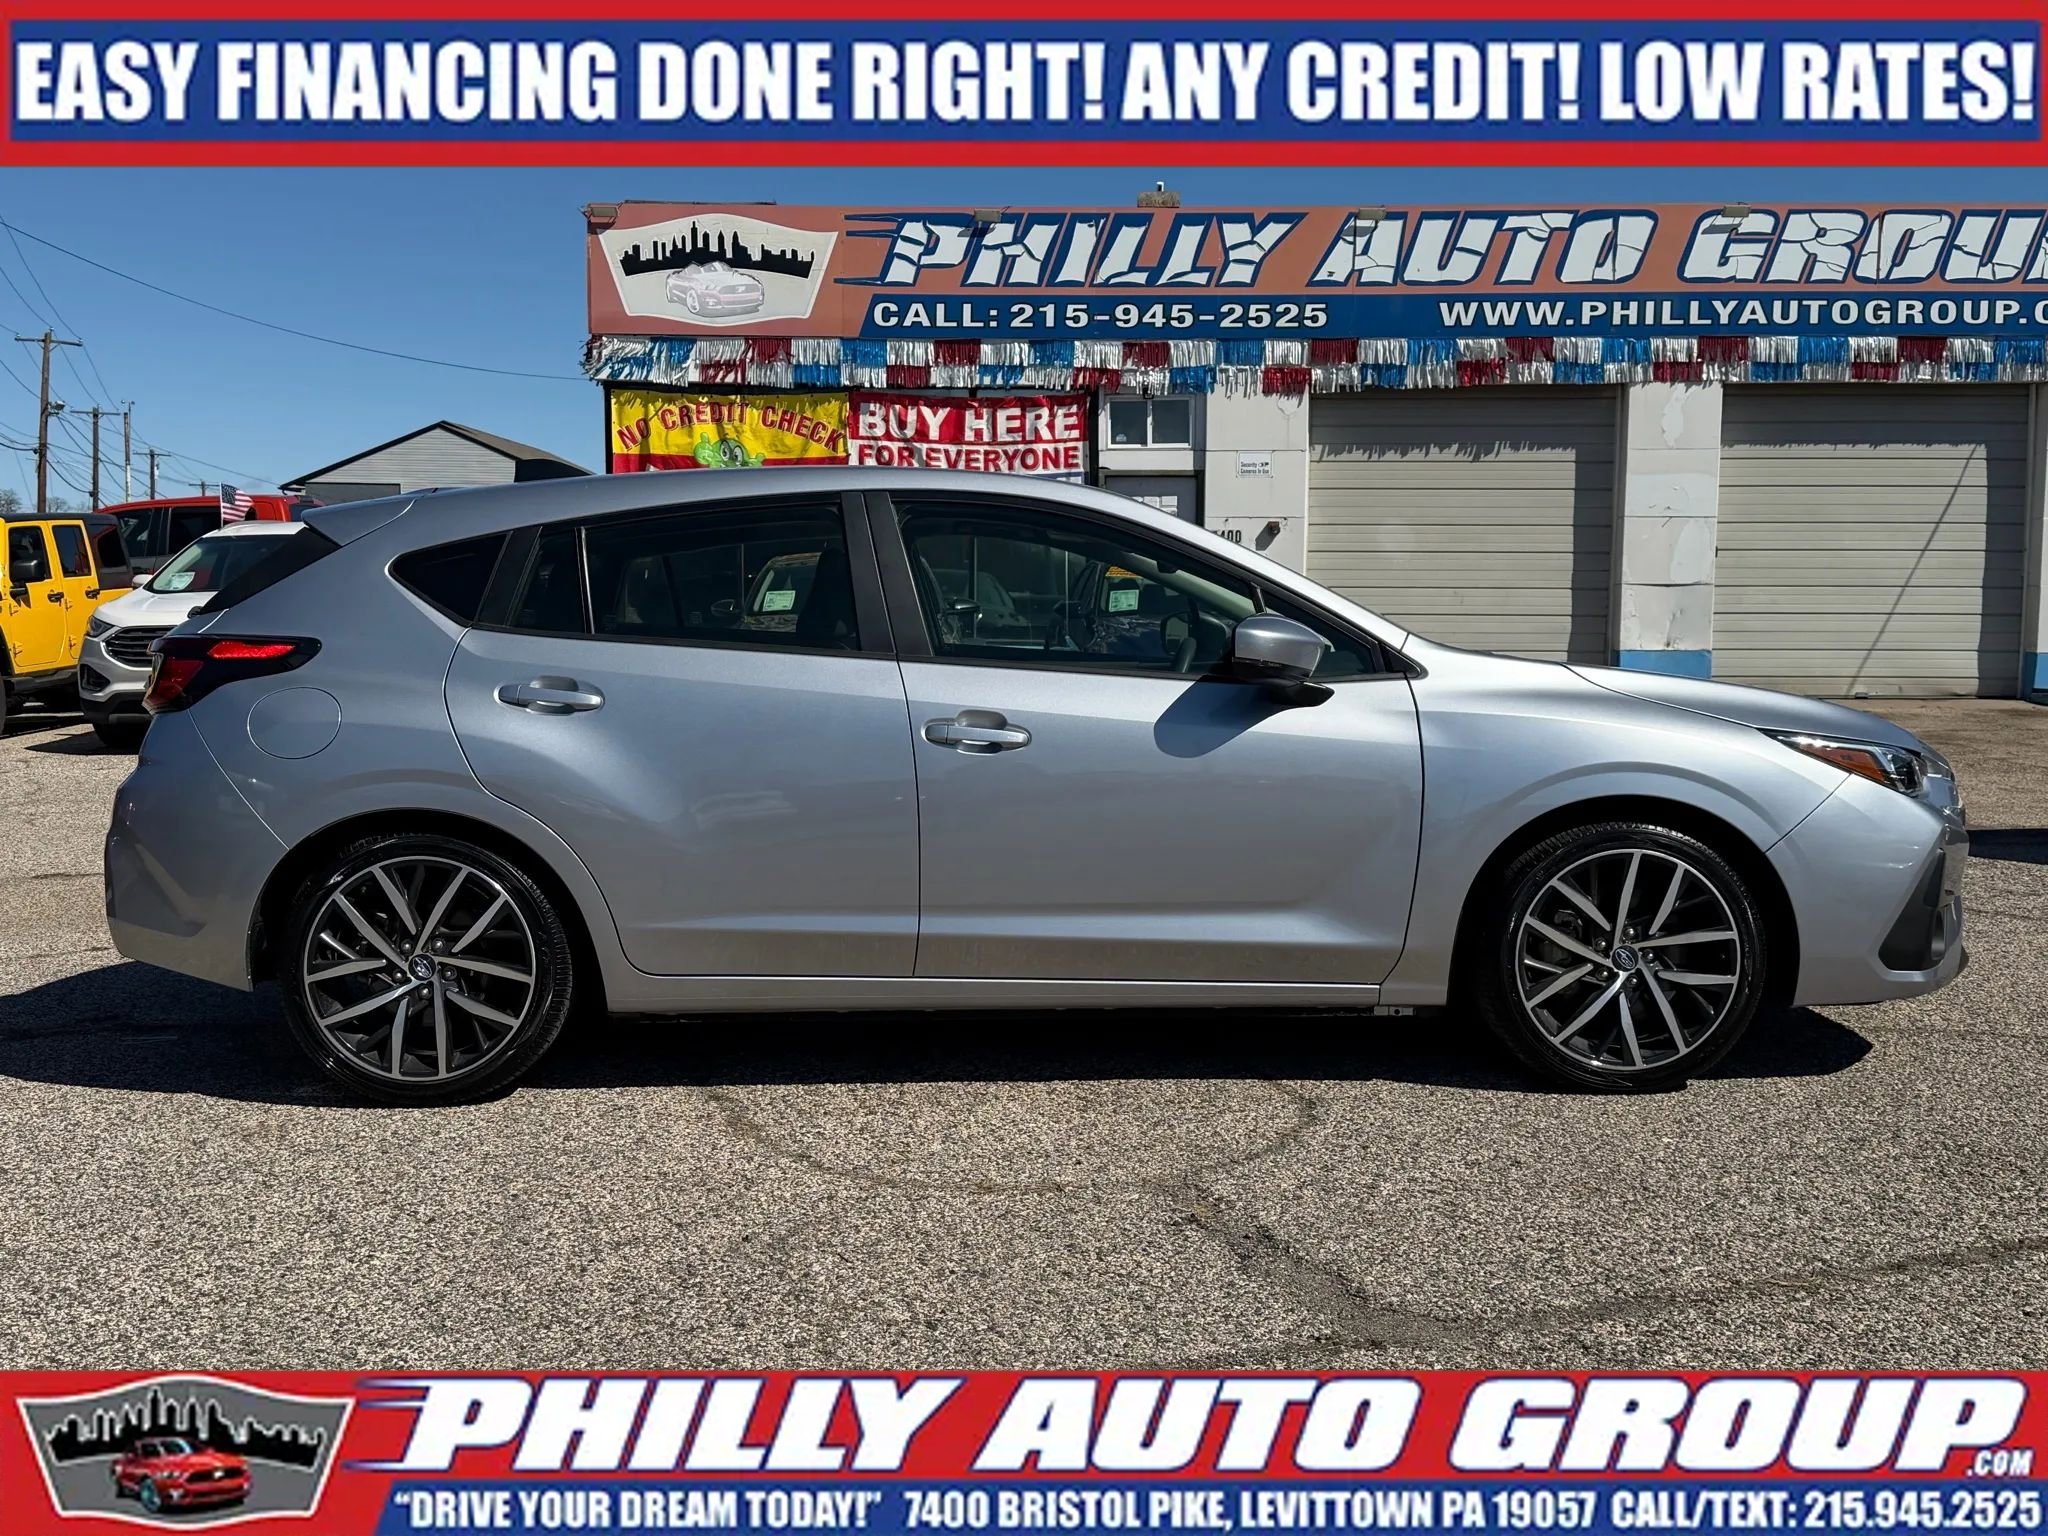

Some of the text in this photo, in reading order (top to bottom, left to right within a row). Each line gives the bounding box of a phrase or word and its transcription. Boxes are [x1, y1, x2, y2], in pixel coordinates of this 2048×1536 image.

[879, 213, 1302, 286] PHILLY
[1308, 211, 1657, 286] AUTO
[873, 301, 1329, 329] CALL: 215-945-2525
[617, 401, 846, 456] NO CREDIT CHECK
[858, 403, 1081, 442] BUY HERE
[858, 443, 1081, 472] FOR EVERYONE
